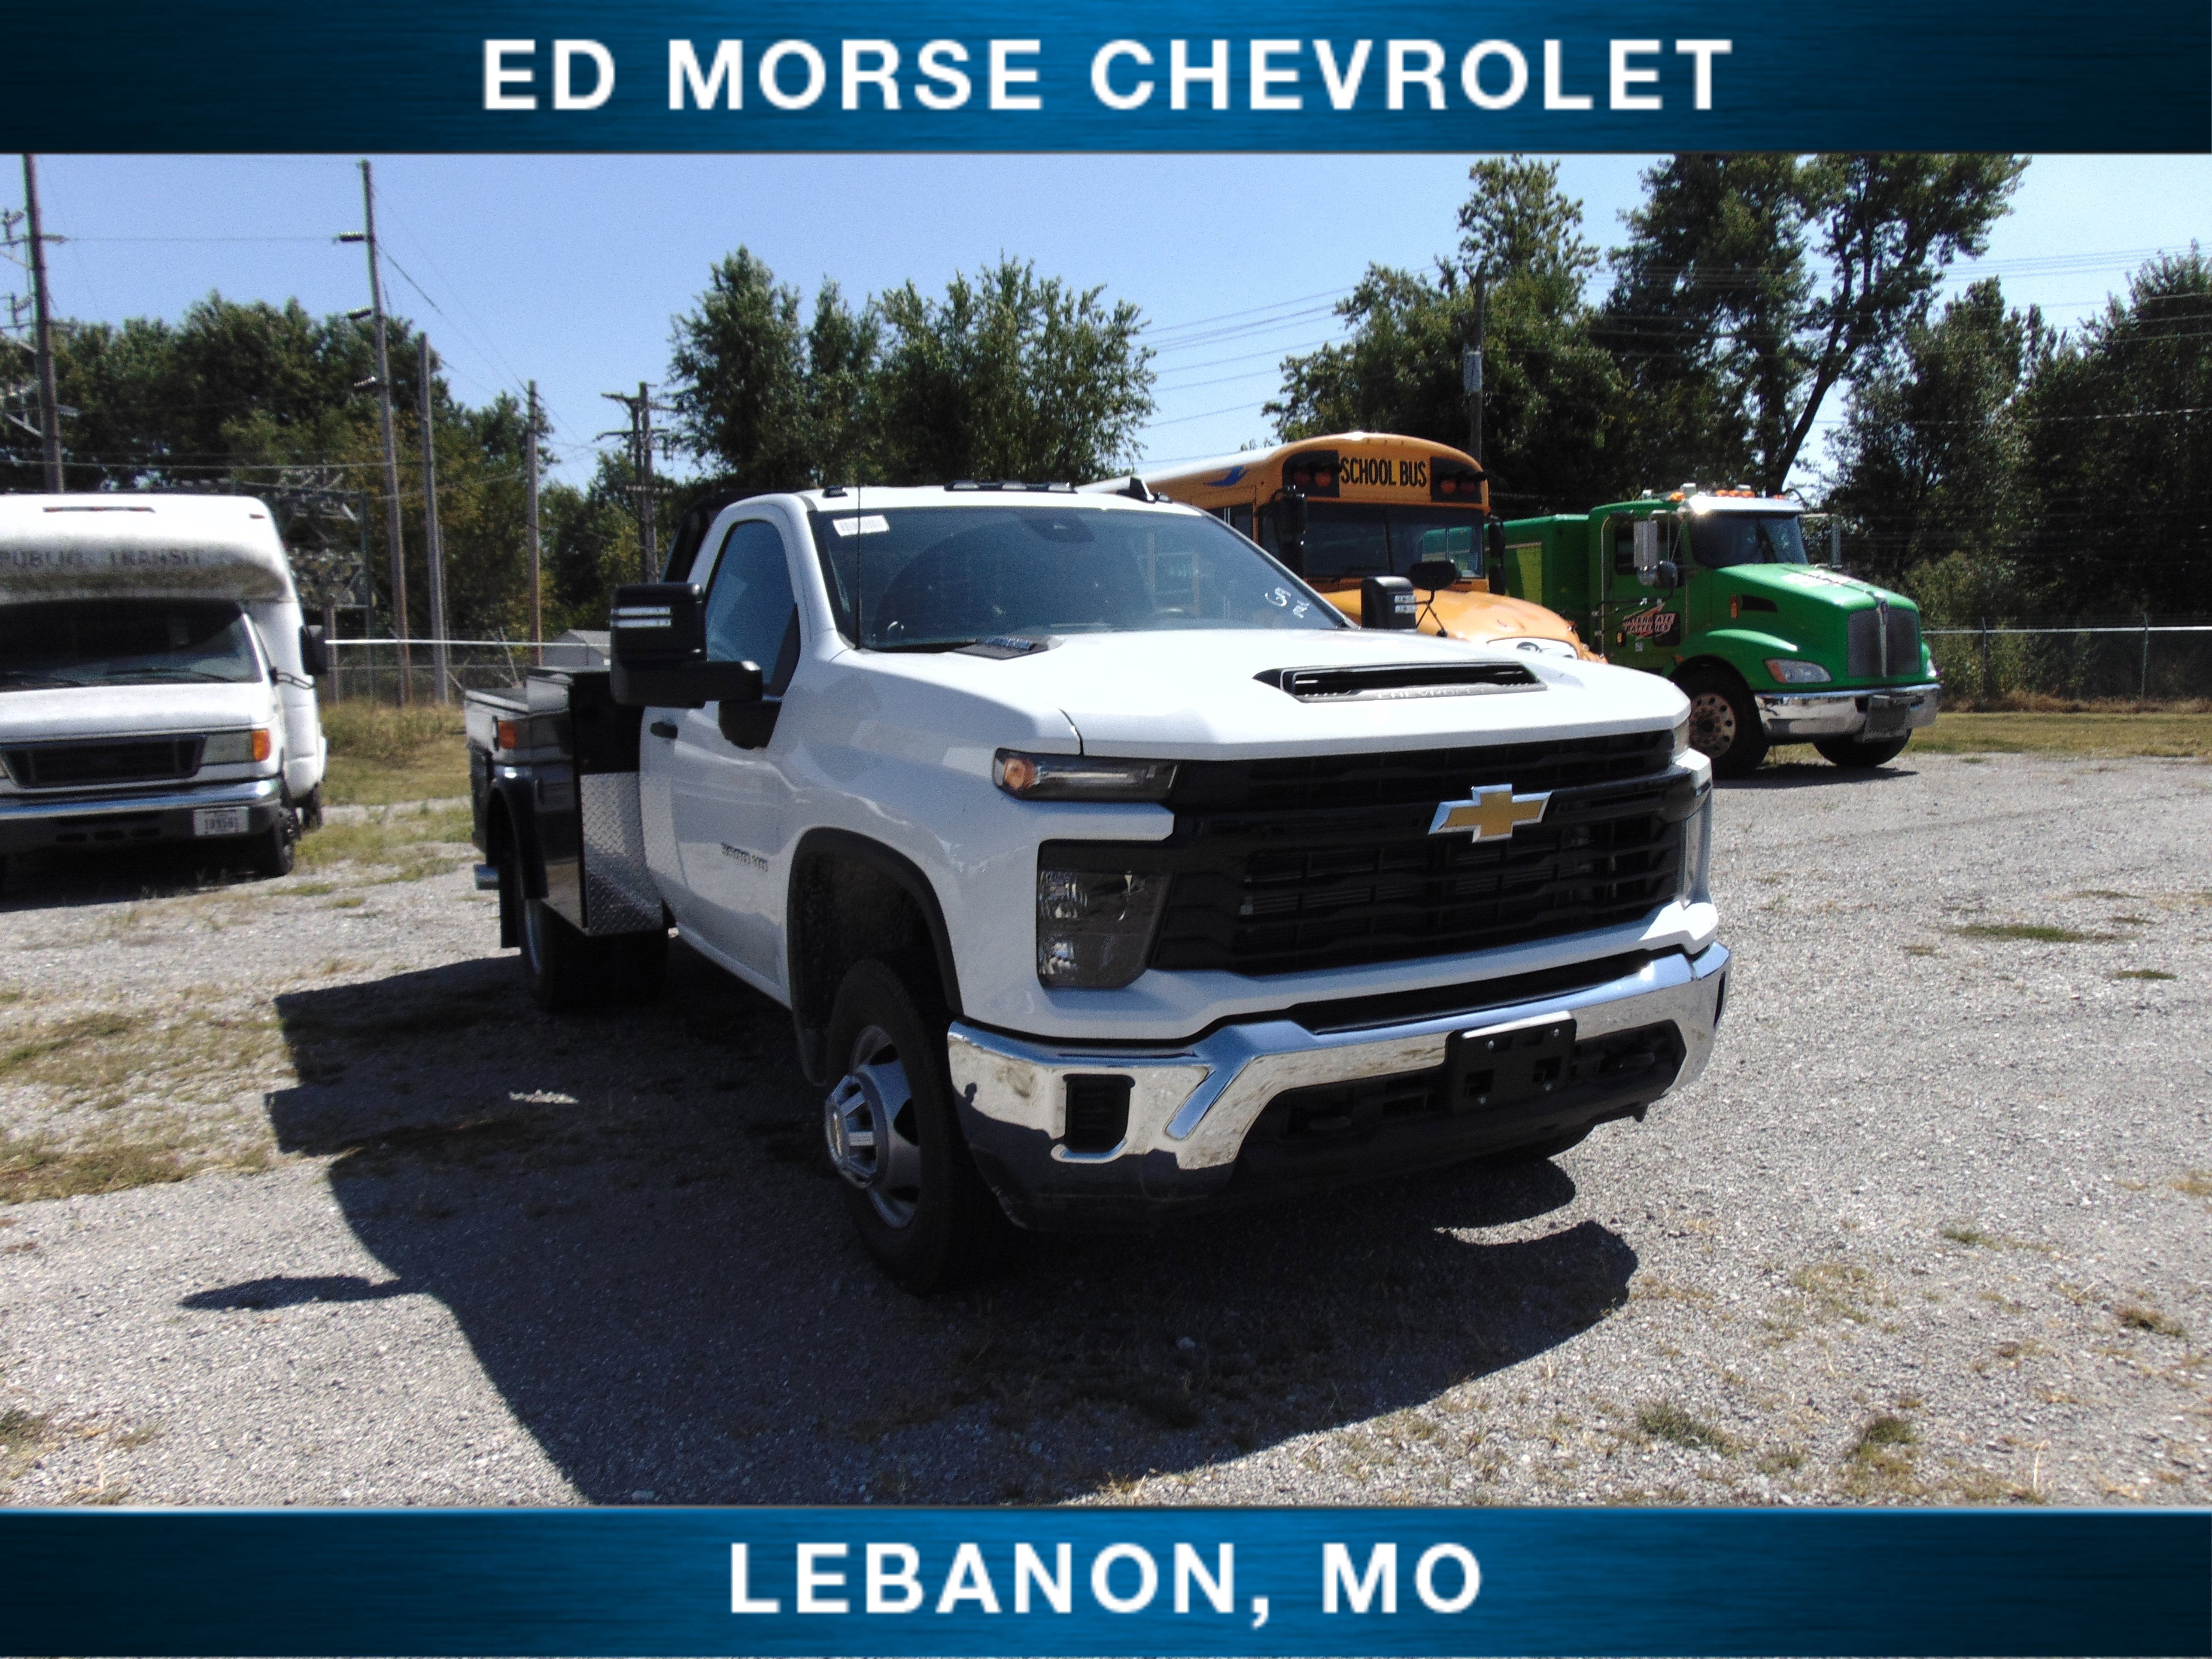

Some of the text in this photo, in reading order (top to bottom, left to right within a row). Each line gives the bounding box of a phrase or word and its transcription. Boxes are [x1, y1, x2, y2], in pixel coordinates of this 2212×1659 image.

[1340, 456, 1427, 487] SCHOOL BUS
[106, 549, 202, 565] TRANSIT
